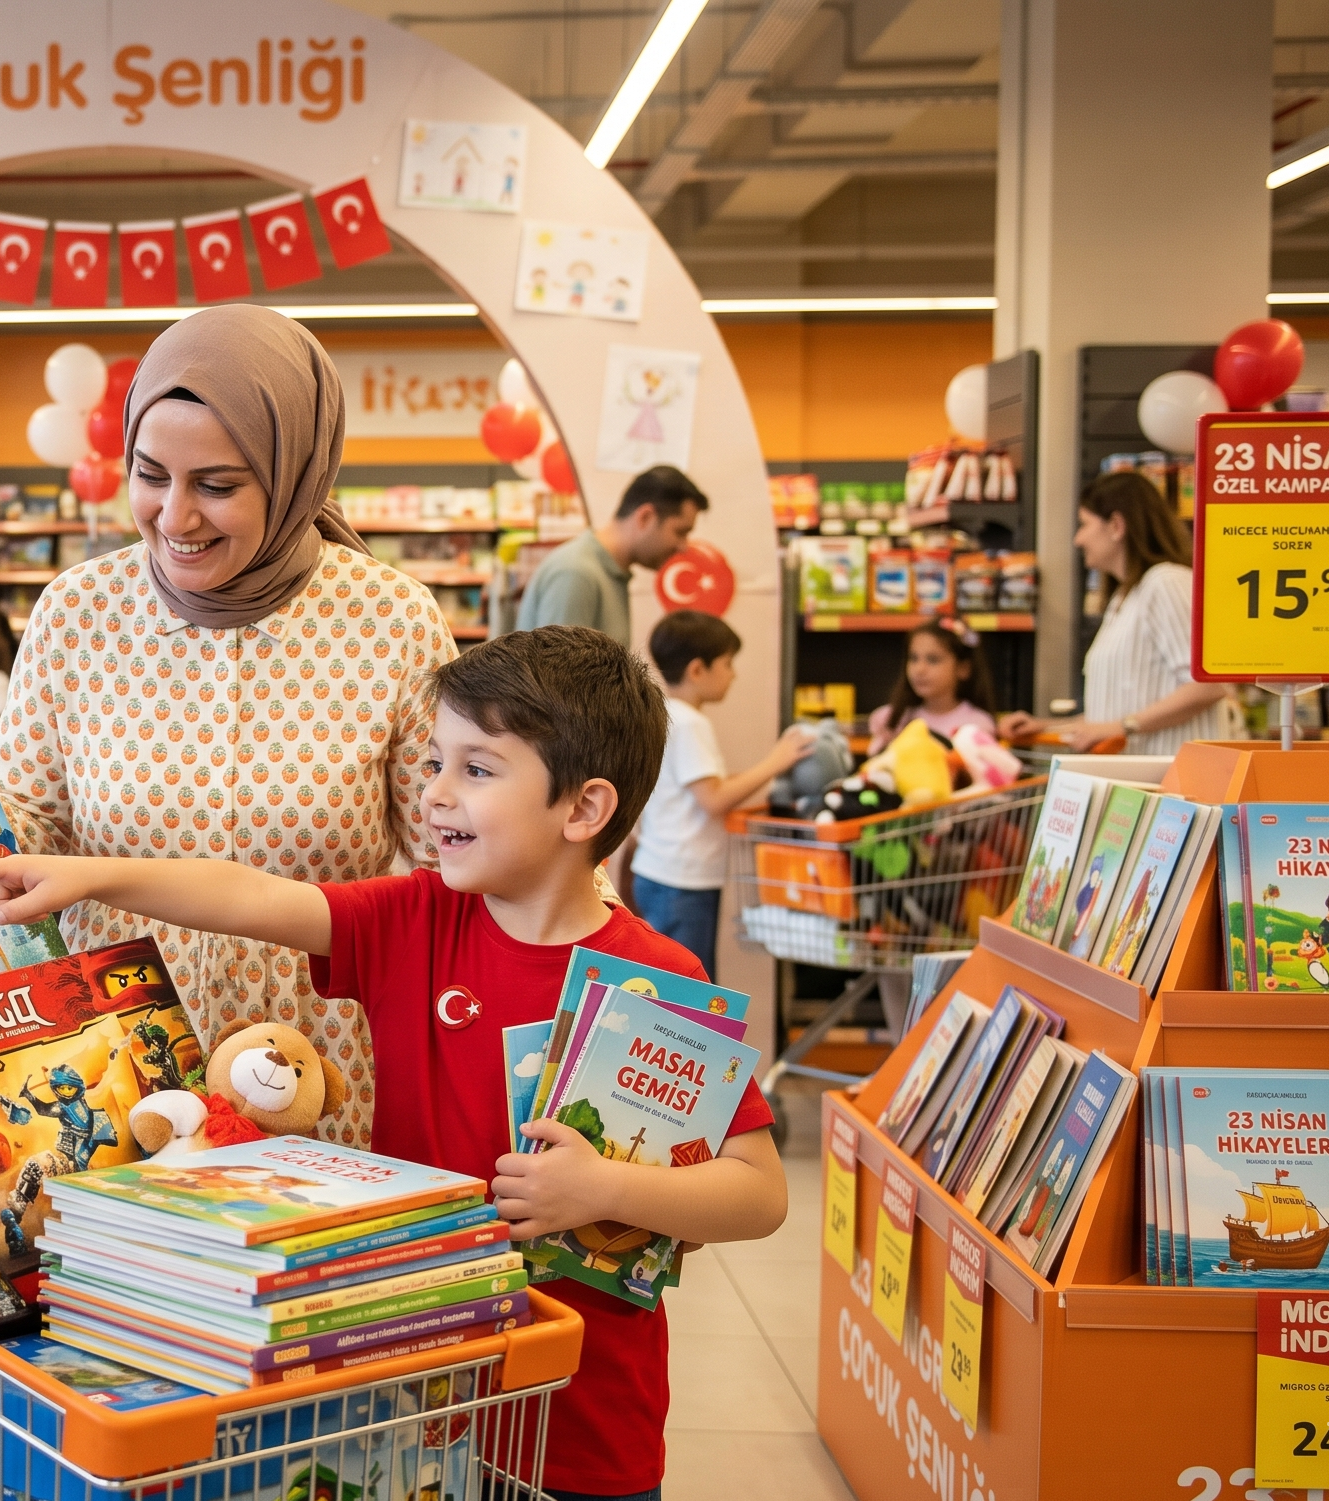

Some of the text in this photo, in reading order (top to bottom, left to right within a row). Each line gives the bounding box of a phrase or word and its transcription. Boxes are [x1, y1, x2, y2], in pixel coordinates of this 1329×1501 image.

[112, 37, 366, 125] Şenliği
[1214, 434, 1329, 471] 23 NİS
[1213, 475, 1259, 494] ÖZEL
[1288, 838, 1312, 854] 23
[627, 1036, 707, 1088] MASAL
[616, 1066, 702, 1117] GEMİSİ
[1227, 1108, 1327, 1131] 23 NİSAN
[839, 1306, 900, 1441] ÇOCUK
[1280, 1383, 1316, 1391] MIGROS
